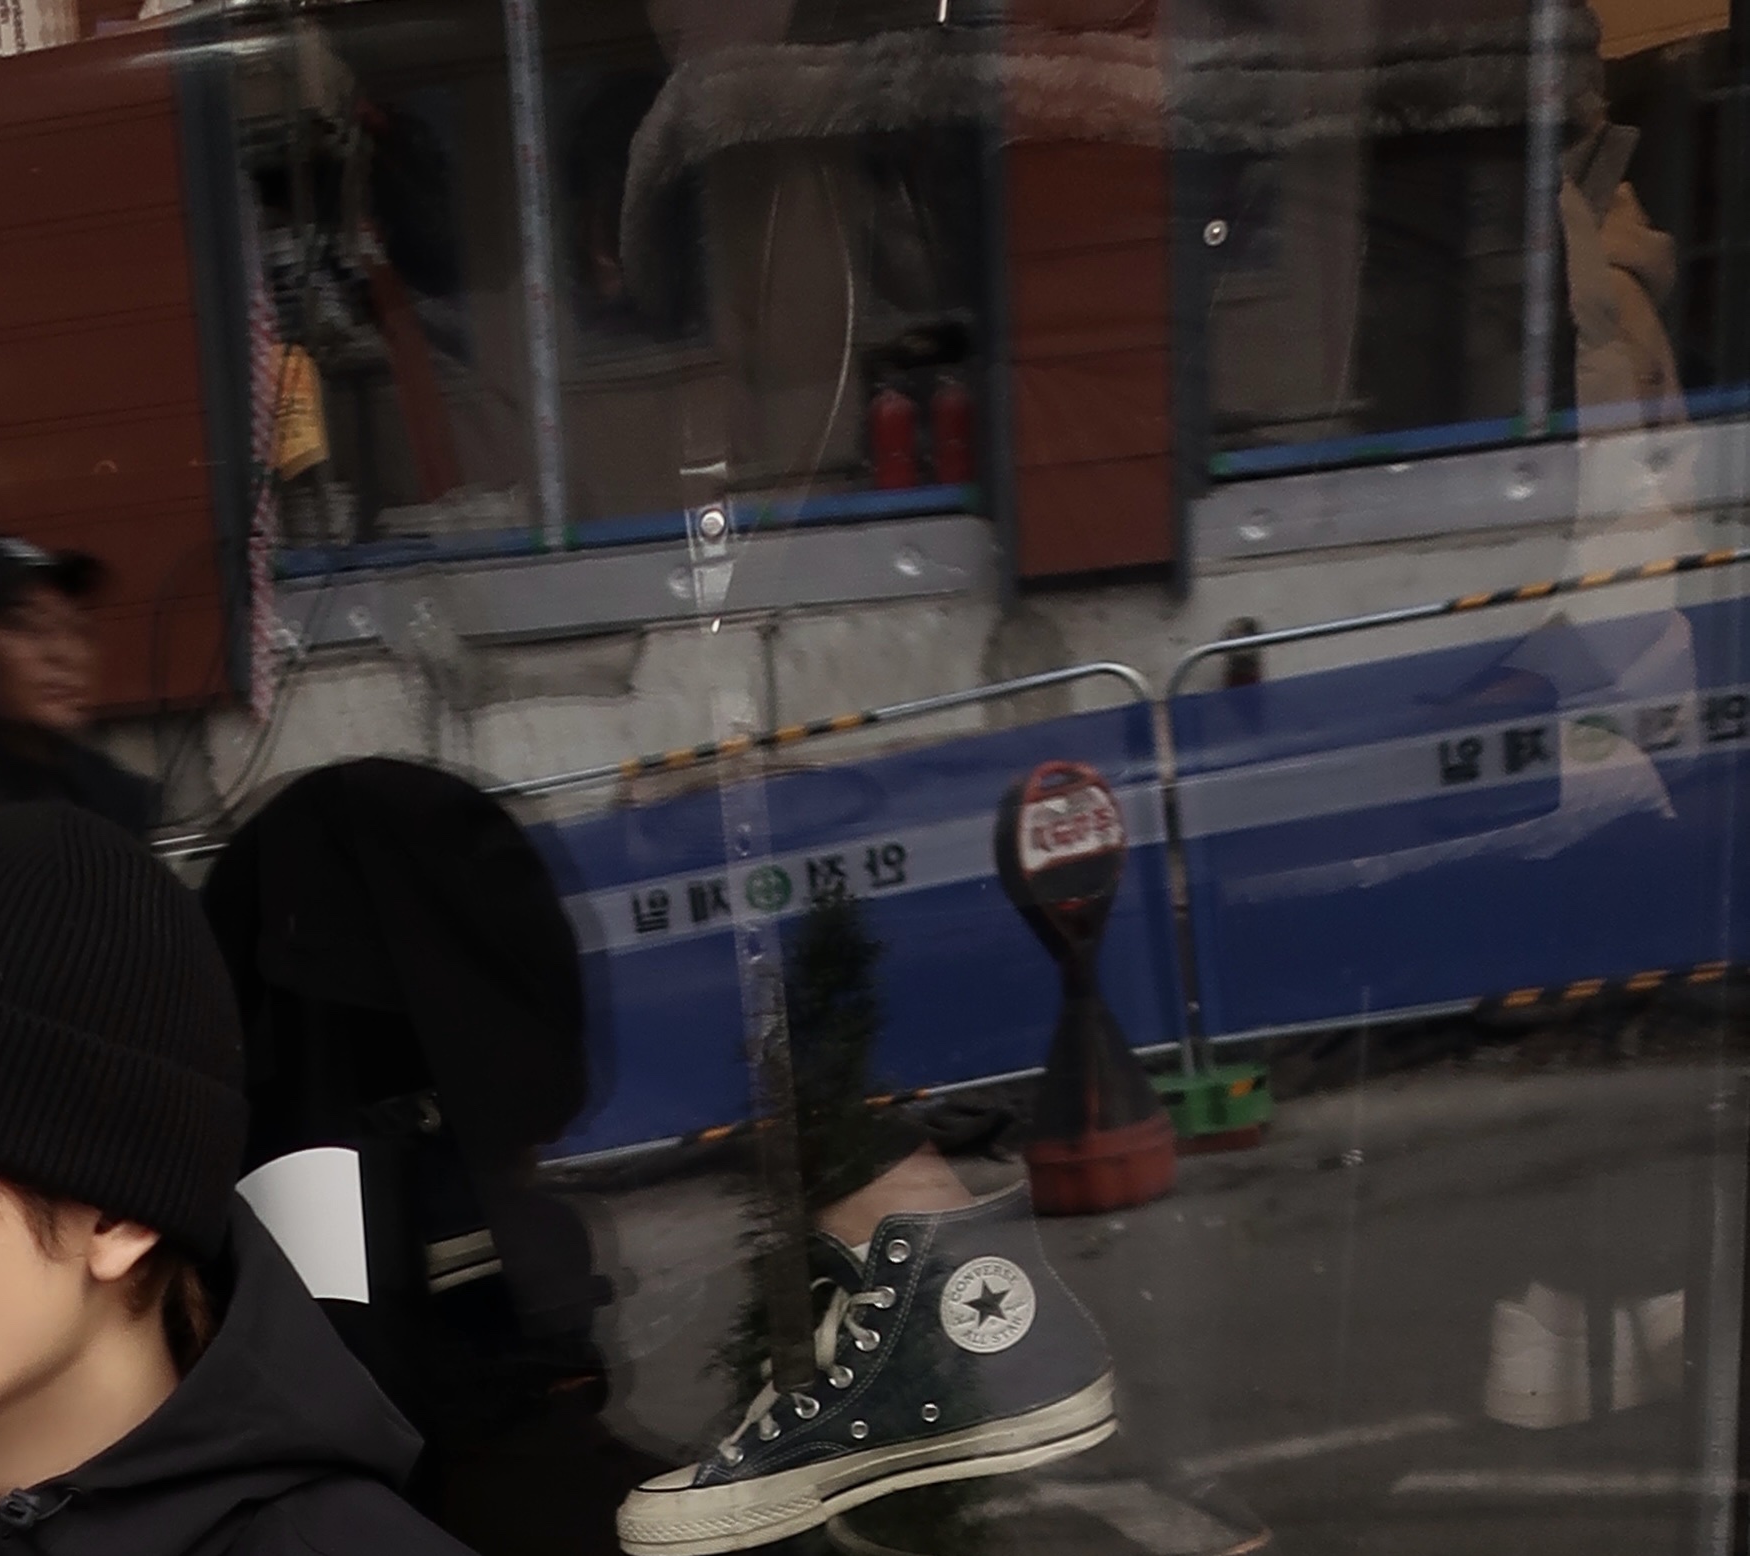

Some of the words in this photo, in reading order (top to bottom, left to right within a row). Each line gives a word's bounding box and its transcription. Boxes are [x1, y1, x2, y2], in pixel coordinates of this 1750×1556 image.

[951, 1265, 1017, 1302] CONVERSE
[963, 1328, 986, 1345] ALL
[992, 1316, 1022, 1344] STAR
